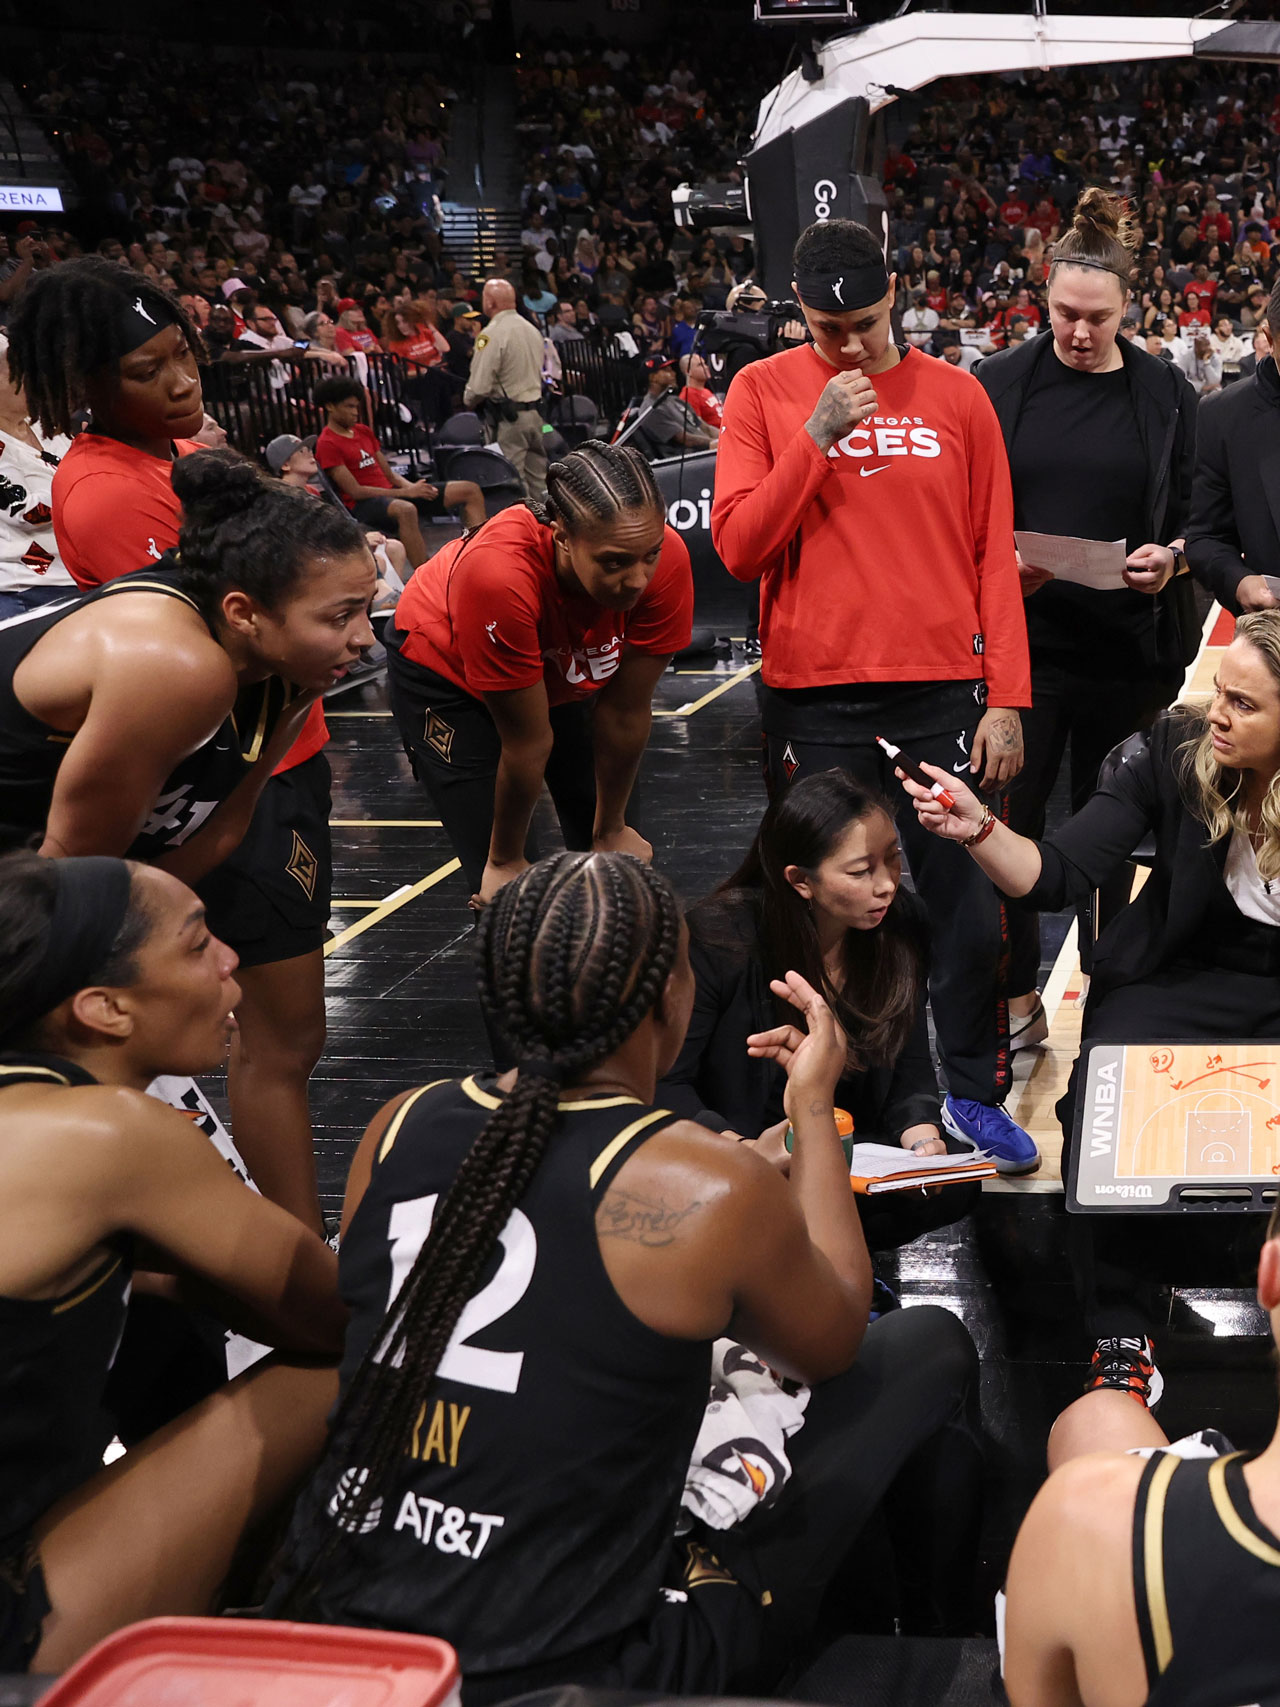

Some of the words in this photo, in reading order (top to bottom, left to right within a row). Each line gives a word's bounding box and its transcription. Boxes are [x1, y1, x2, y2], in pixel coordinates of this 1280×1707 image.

[0, 193, 47, 205] RENA
[814, 179, 838, 224] Go
[862, 416, 924, 426] VEGAS
[1090, 1061, 1118, 1157] WNBA
[1095, 1184, 1153, 1198] Wilson
[372, 1193, 538, 1394] 12
[394, 1491, 505, 1560] AT&T
